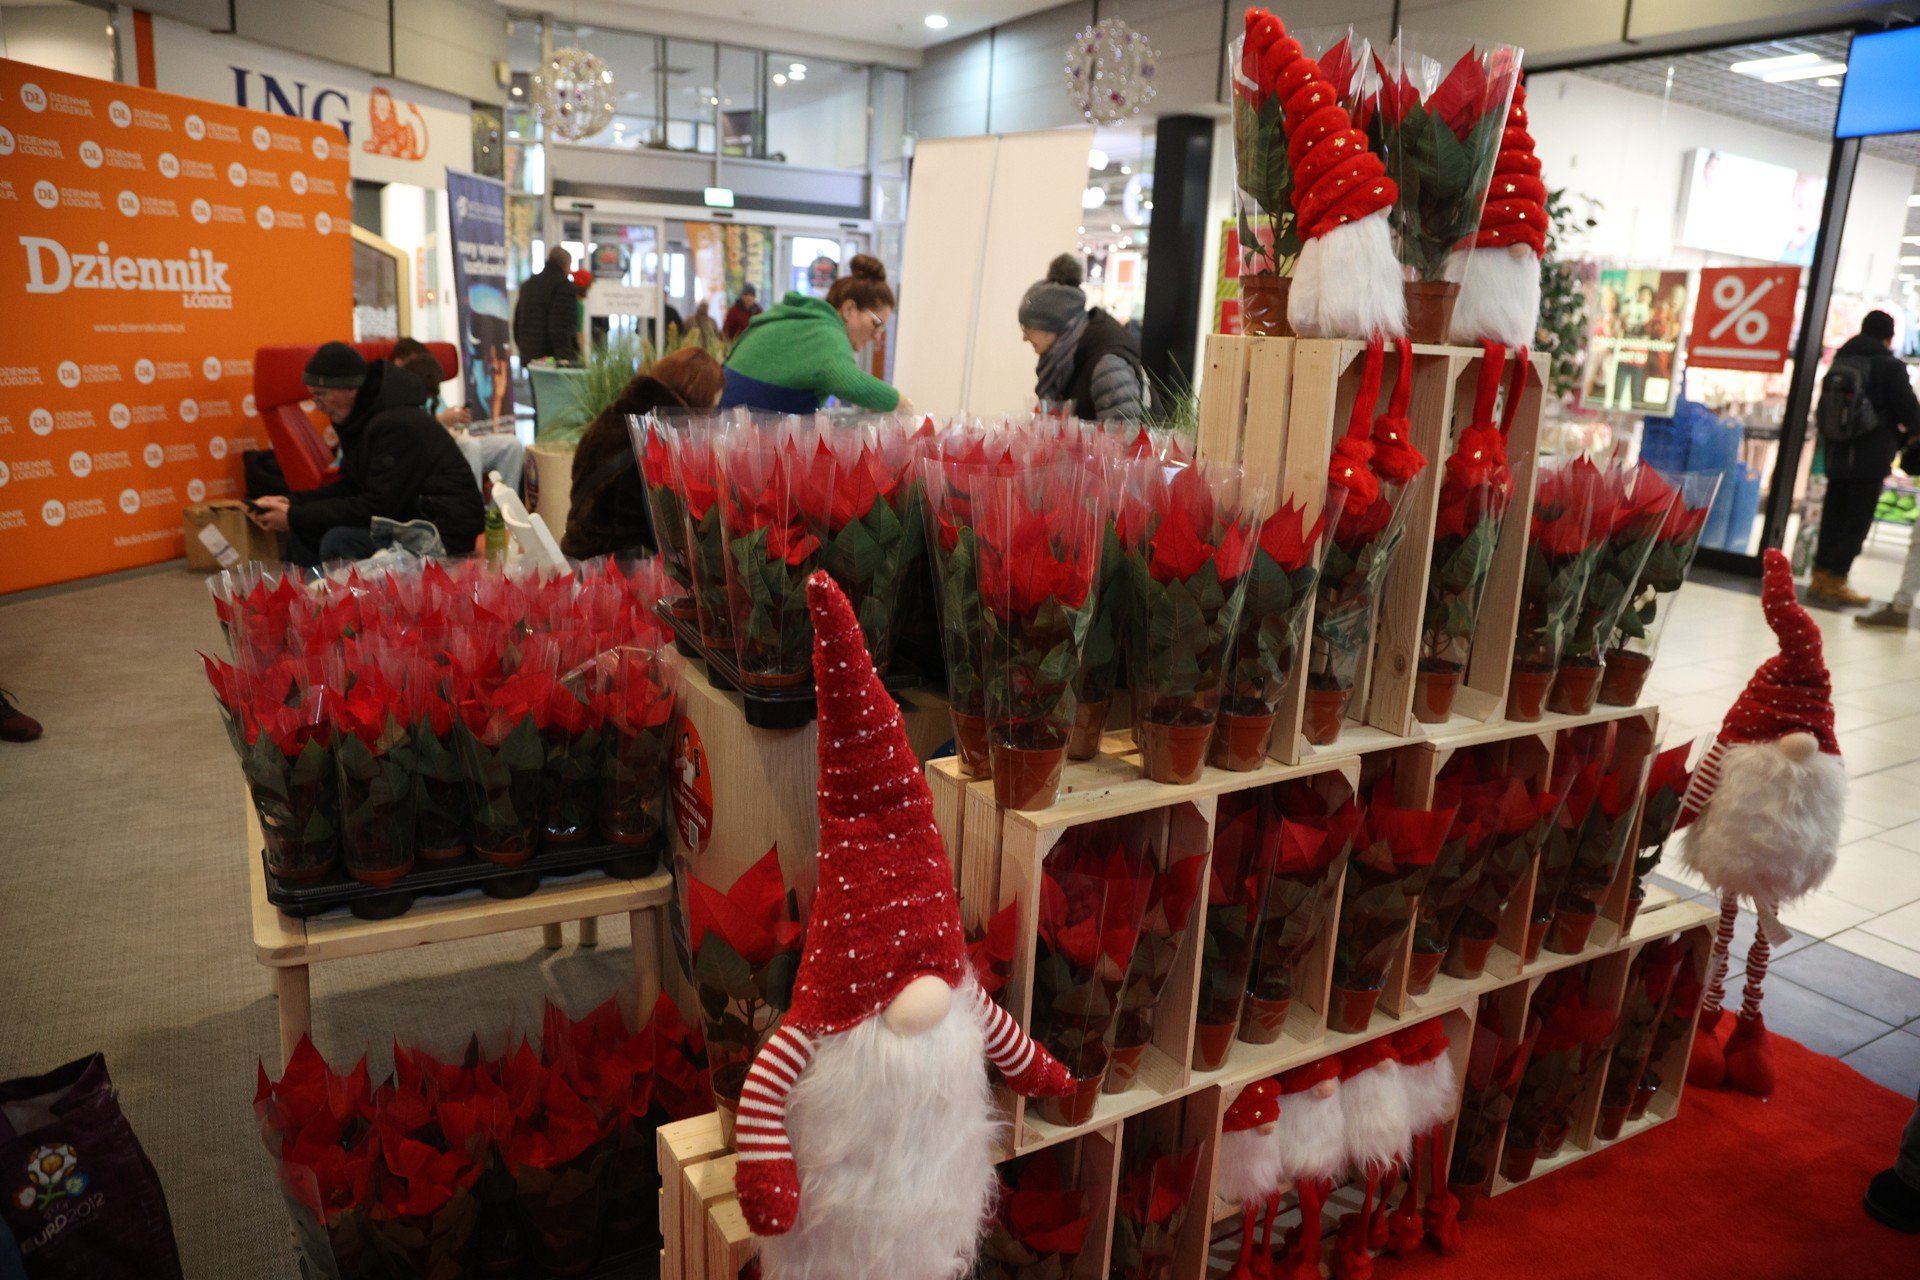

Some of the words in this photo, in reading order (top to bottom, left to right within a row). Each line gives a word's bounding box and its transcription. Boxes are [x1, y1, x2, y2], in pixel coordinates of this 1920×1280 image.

[229, 66, 355, 143] ING
[18, 235, 231, 294] Dziennik
[1709, 275, 1774, 345] %
